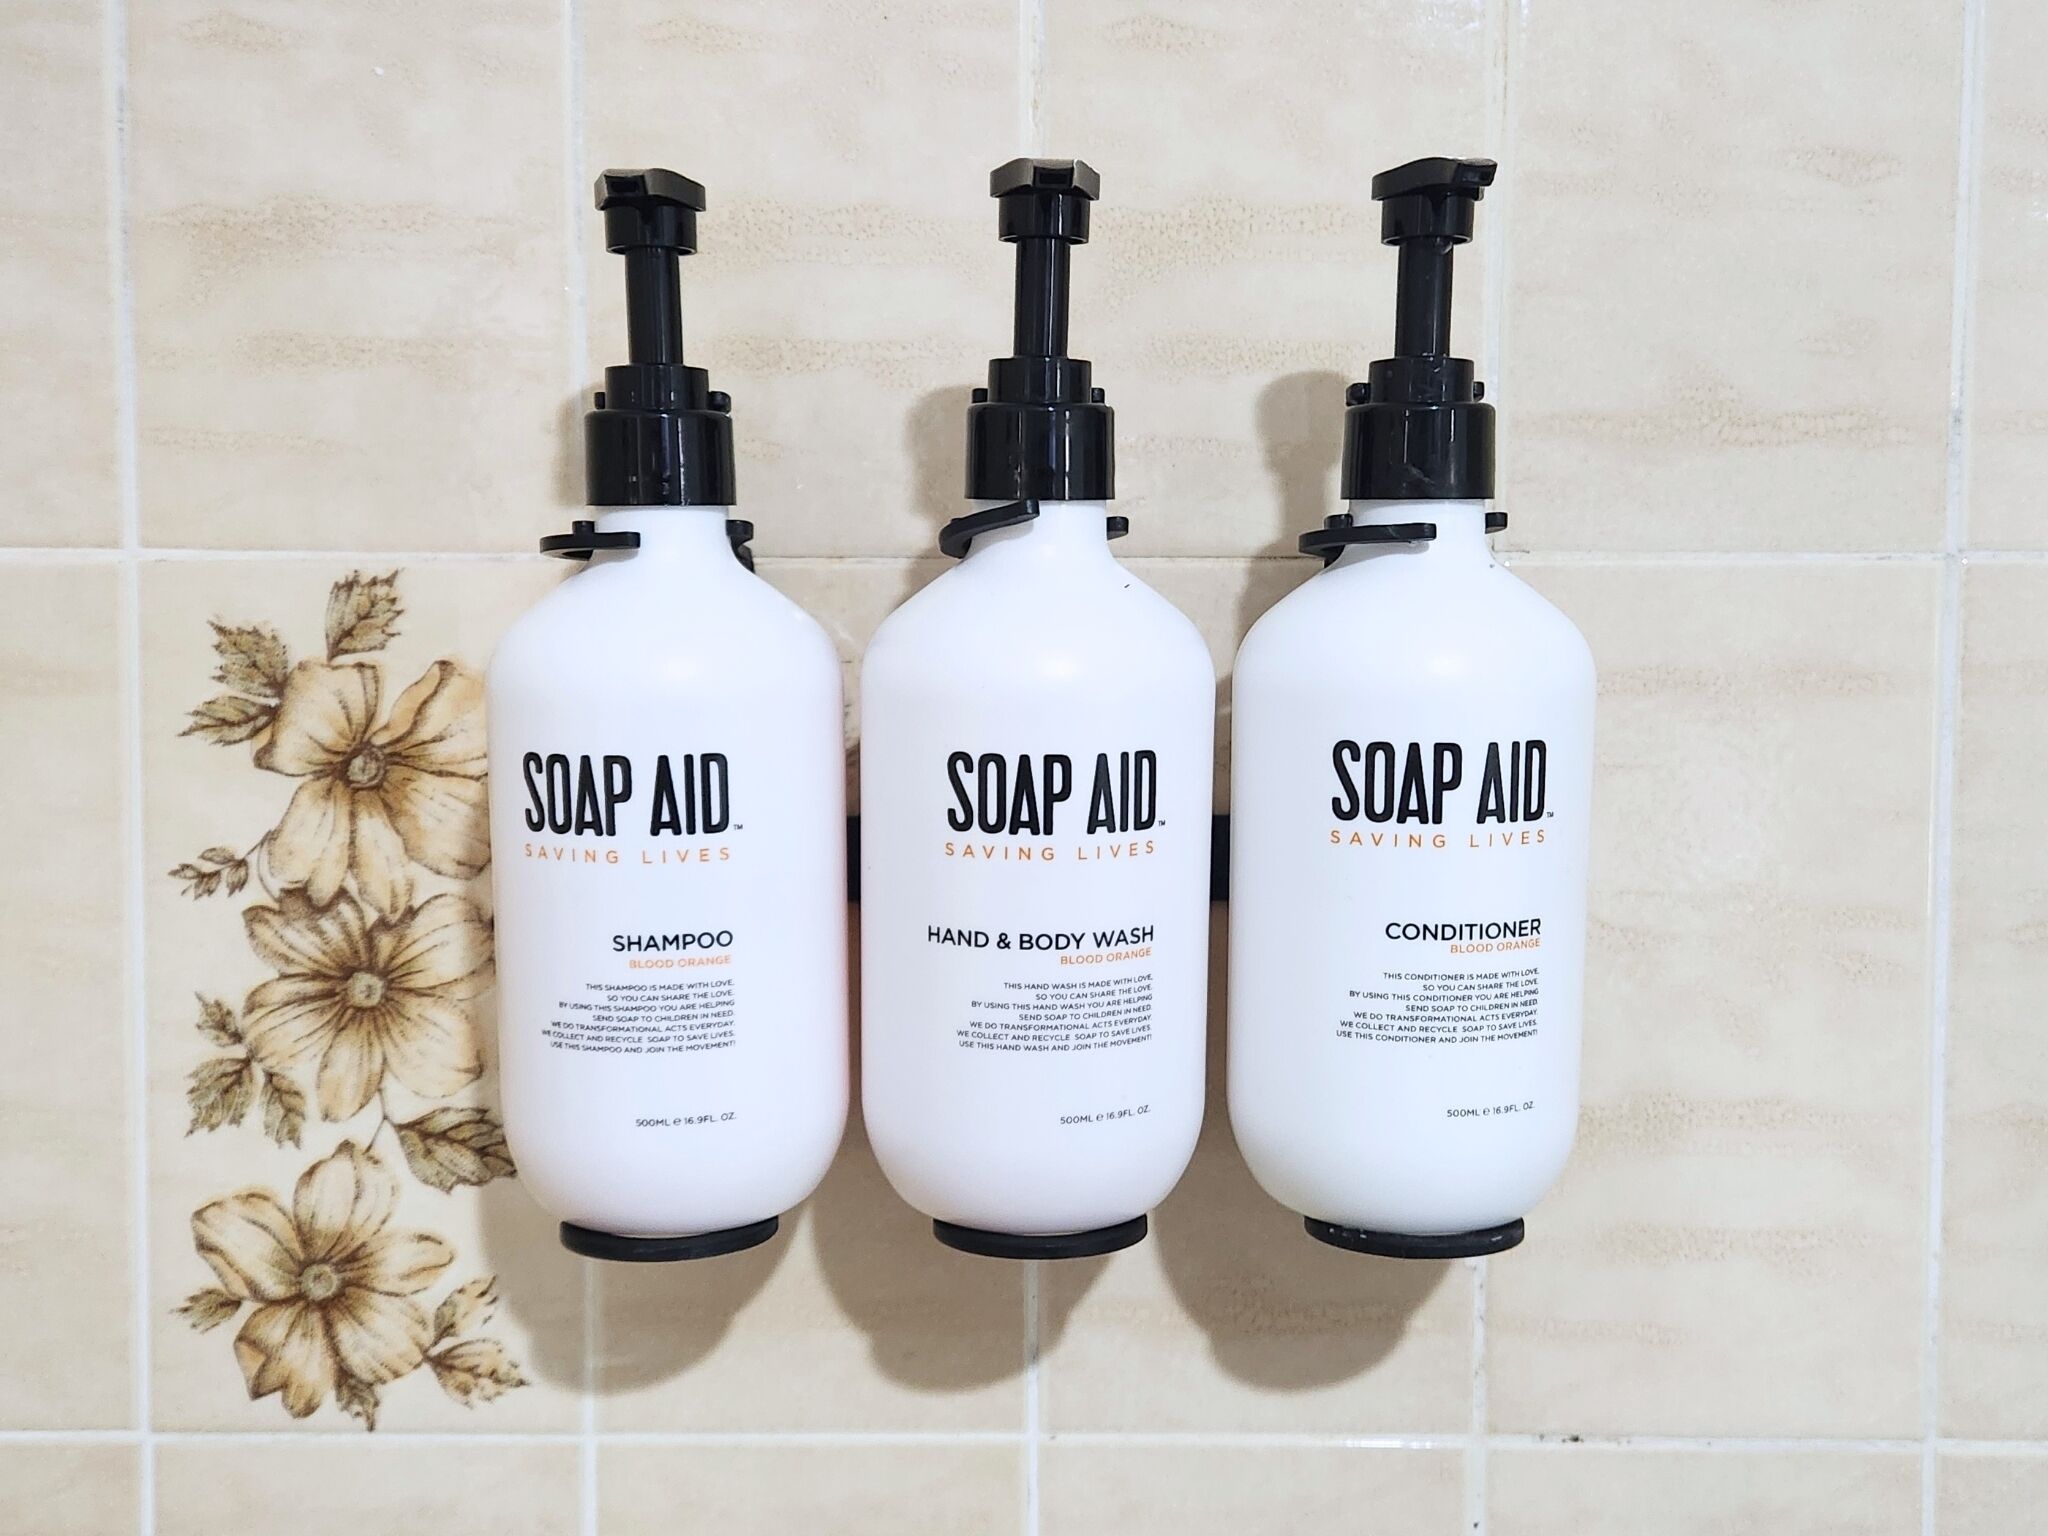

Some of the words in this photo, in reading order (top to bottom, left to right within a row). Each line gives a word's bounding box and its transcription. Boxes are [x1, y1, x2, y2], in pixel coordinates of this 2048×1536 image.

[1332, 740, 1462, 824] SOAP
[1476, 740, 1547, 824] AID
[522, 752, 632, 836] SOAP
[650, 752, 730, 836] AID
[947, 751, 1072, 835] SOAP
[1087, 750, 1156, 834] AID
[1331, 830, 1446, 848] SAVING
[1470, 829, 1545, 847] LIVES
[524, 844, 618, 864] SAVING
[642, 848, 730, 864] LIVES
[945, 842, 1055, 860] SAVING
[1078, 841, 1154, 860] LIVES
[1385, 919, 1541, 941] CONDITIONER
[612, 930, 733, 952] SHAMPOO
[928, 925, 989, 947] HAND
[997, 933, 1011, 949] &
[1019, 933, 1085, 950] BODY
[1093, 925, 1154, 948] WASH
[1450, 944, 1493, 953] BLOOD
[1497, 938, 1541, 951] ORANGE
[1061, 955, 1103, 965] BLOOD
[1106, 947, 1152, 962] ORANGE
[629, 959, 673, 969] BLOOD
[678, 955, 731, 968] ORANGE
[1404, 973, 1465, 981] CONDITIONER
[1088, 980, 1111, 988] MADE
[1113, 978, 1132, 986] WITH
[661, 993, 690, 1001] SHARE
[1090, 990, 1116, 998] SHARE
[1511, 989, 1539, 998] HELPING
[699, 1000, 735, 1009] HELPING
[1106, 999, 1122, 1007] ARE
[1123, 994, 1152, 1005] HELPING
[1470, 1003, 1509, 1011] CHILDREN
[1083, 1009, 1122, 1019] CHILDREN
[1386, 1014, 1477, 1022] TRANSFORMATIONAL
[576, 1023, 662, 1032] TRANSFORMATIONAL
[1000, 1023, 1089, 1031] TRANSFORMATIONAL
[1340, 1020, 1353, 1028] WE
[1356, 1022, 1394, 1031] COLLECT
[1499, 1022, 1516, 1030] SAVE
[971, 1032, 1009, 1040] COLLECT
[1075, 1032, 1097, 1040] SOAP
[1111, 1028, 1130, 1036] SAVE
[1336, 1030, 1352, 1038] USE
[1355, 1032, 1373, 1040] THIS
[1375, 1034, 1436, 1043] CONDITIONER
[1094, 1041, 1108, 1049] THE
[1447, 1109, 1480, 1117] 500ML
[636, 1119, 670, 1127] 500ML
[1060, 1115, 1093, 1124] 500ML
